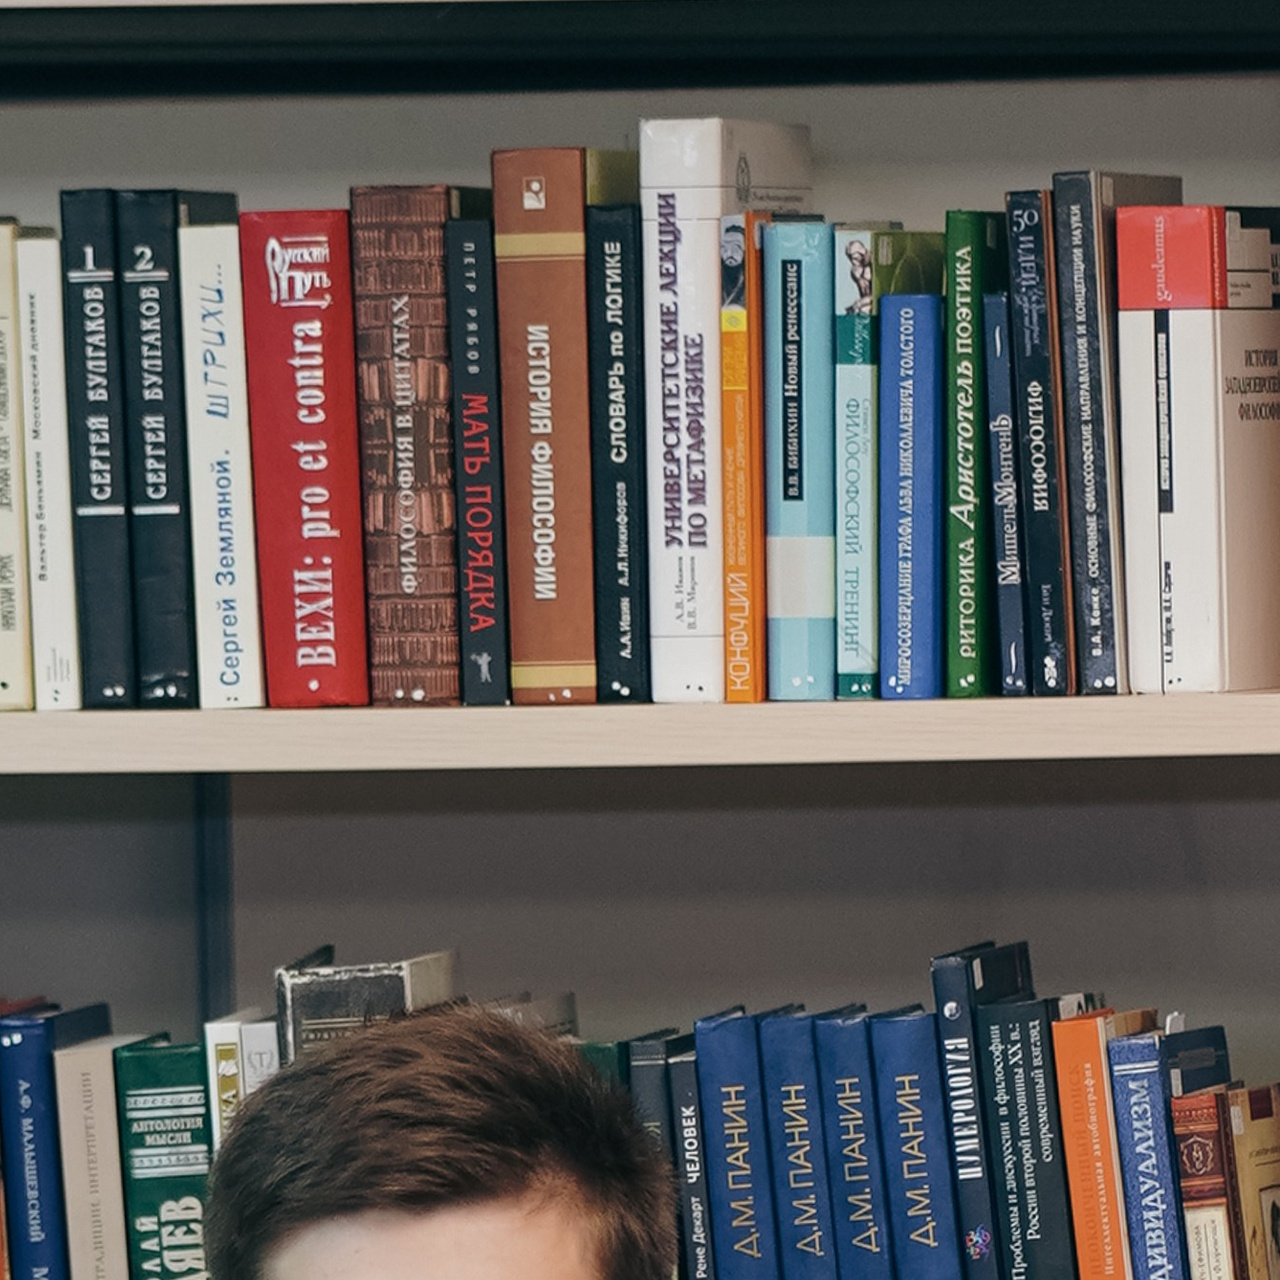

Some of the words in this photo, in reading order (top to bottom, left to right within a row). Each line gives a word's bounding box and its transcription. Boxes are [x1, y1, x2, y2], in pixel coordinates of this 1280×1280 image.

[82, 245, 97, 271] 1
[133, 245, 155, 271] 2
[461, 241, 477, 292] ПЕТР
[657, 191, 682, 297] ЛЕКЦИИ
[1070, 204, 1083, 245] НАУКИ
[1152, 215, 1172, 302] gaudeamus
[27, 292, 41, 352] дневник
[602, 240, 623, 326] ЛОГИКЕ
[784, 263, 803, 341] ренессанс
[953, 245, 975, 354] ПОЭТИКА
[1073, 247, 1088, 323] КОНЦЕПЦИИ
[82, 286, 109, 402] БУЛГАКОВ
[138, 286, 164, 402] БУЛГАКОВ
[287, 319, 326, 423] contra
[391, 293, 416, 407] ЦИТАТАХ
[526, 323, 553, 434] ИСТОРИЯ
[610, 330, 625, 356] по
[783, 343, 800, 397] Новый
[899, 307, 915, 376] ТОЛСТОГО
[1077, 335, 1093, 421] НАПРАВЛЕНИЯ
[29, 355, 42, 441] Московский
[395, 413, 413, 429] В
[461, 393, 495, 475] МАТЬ
[605, 361, 627, 463] СЛОВАРЬ
[661, 300, 684, 549] УНИВЕРСИТЕТСКИЕ
[684, 332, 707, 507] МЕТАФИЗИКЕ
[785, 402, 800, 470] БИБИХИН
[898, 379, 914, 477] НИКОЛАЕВИЧА
[85, 416, 112, 501] СЕРГЕЙ
[141, 415, 167, 500] СЕРГЕЙ
[290, 440, 327, 471] et
[843, 398, 863, 555] ФИЛОСОФСКИЙ
[950, 361, 979, 531] Аристотель
[1026, 380, 1049, 512] ФИЛОСОФИЯ
[1081, 422, 1098, 513] ФИЛОСОФСКИЕ
[210, 448, 237, 587] Земляной.
[296, 486, 340, 540] pro
[396, 436, 419, 594] ФИЛОСОФИЯ
[528, 441, 557, 600] ФИЛОСОФИИ
[687, 513, 708, 549] ПО
[897, 517, 913, 559] ГРАФА
[898, 479, 914, 514] ЛЬВА
[36, 523, 49, 581] Вальтер
[464, 484, 497, 632] ПОРЯДКА
[1086, 514, 1100, 578] ОСНОВНЫЕ
[292, 554, 336, 667] ВЕХИ:
[726, 572, 750, 691] КОНФУЦИЙ
[844, 567, 861, 658] ТРЕНИНГ
[897, 560, 914, 686] МИРОСОЗЕРЦАНИЕ
[958, 537, 977, 658] РИТОРИКА
[217, 598, 244, 687] Сергей
[988, 1024, 1010, 1105] философии
[1027, 1019, 1045, 1067] взгляд
[780, 1084, 813, 1189] ПАНИН
[835, 1076, 869, 1182] ПАНИН
[894, 1074, 929, 1180] ПАНИН
[943, 1036, 984, 1181] НУМЕРОЛОГИЯ
[1014, 1068, 1032, 1137] половины
[1033, 1068, 1055, 1163] современный
[1066, 1063, 1089, 1124] ПОИСК
[1082, 1062, 1102, 1158] автобиография
[679, 1104, 702, 1184] ЧЕЛОВЕК
[721, 1085, 752, 1190] ПАНИН
[999, 1122, 1018, 1192] дискуссии
[1020, 1138, 1038, 1188] второй
[689, 1196, 707, 1244] Декарт
[731, 1196, 762, 1258] Д.М.
[792, 1195, 825, 1257] Д.М.
[849, 1187, 881, 1254] Д.М.
[907, 1183, 939, 1249] Д.М.
[1024, 1189, 1041, 1241] России
[1095, 1161, 1115, 1276] Интеллектуальная
[693, 1246, 708, 1280] Рене
